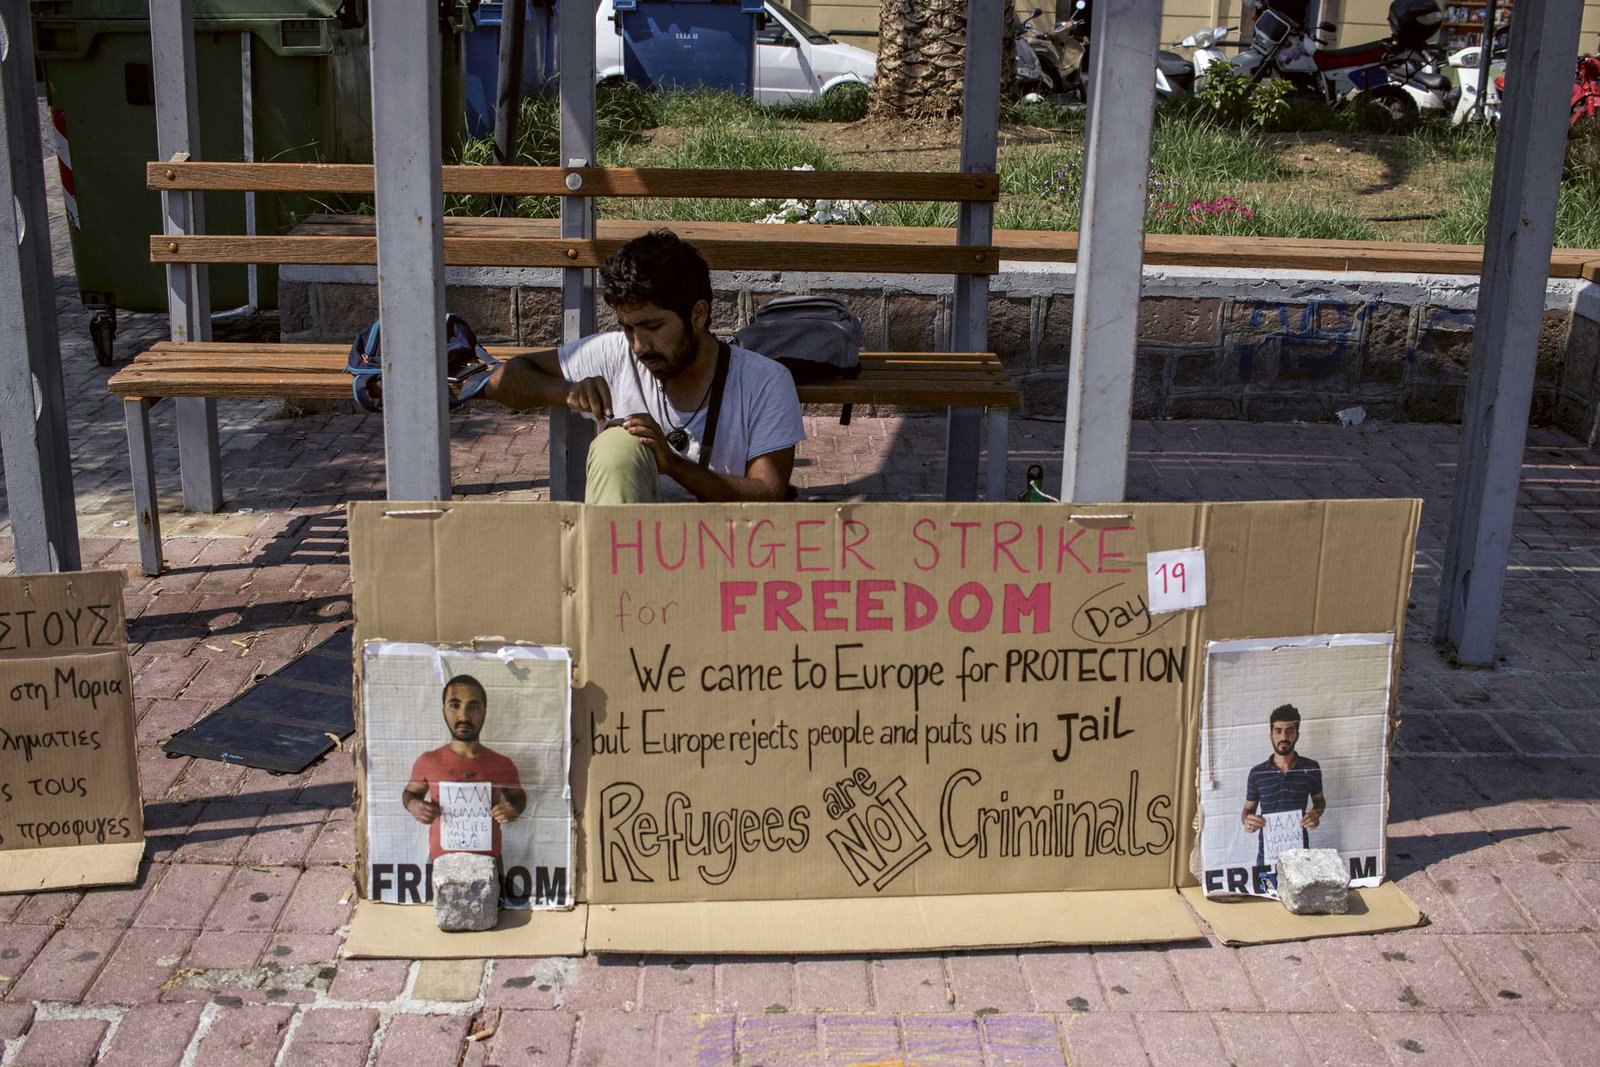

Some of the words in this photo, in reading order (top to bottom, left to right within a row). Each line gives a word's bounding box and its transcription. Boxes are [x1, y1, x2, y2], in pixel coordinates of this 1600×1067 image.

[610, 519, 876, 576] HUNGER
[912, 517, 1136, 575] STRIKE
[1154, 562, 1187, 594] 19
[615, 590, 678, 633] for
[719, 579, 1052, 634] FREEDOM
[1084, 594, 1152, 638] Day
[10, 679, 49, 710] στη
[54, 667, 123, 709] Μορια
[629, 643, 686, 692] We
[701, 664, 783, 692] came
[792, 644, 827, 691] to
[835, 643, 945, 713] Europe
[955, 646, 999, 702] for
[1005, 646, 1187, 683] PROTECTION
[590, 710, 631, 756] but
[642, 708, 725, 769] Europe
[729, 718, 799, 766] rejects
[808, 709, 874, 772] people
[880, 713, 919, 746] and
[925, 713, 972, 765] puts
[981, 722, 1007, 746] us
[1015, 712, 1039, 744] in
[27, 776, 88, 798] τους
[823, 767, 877, 820] are
[939, 768, 1175, 859] Criminals
[17, 817, 131, 845] προσφυγες
[600, 781, 811, 886] Refugees
[826, 775, 927, 887] NOT
